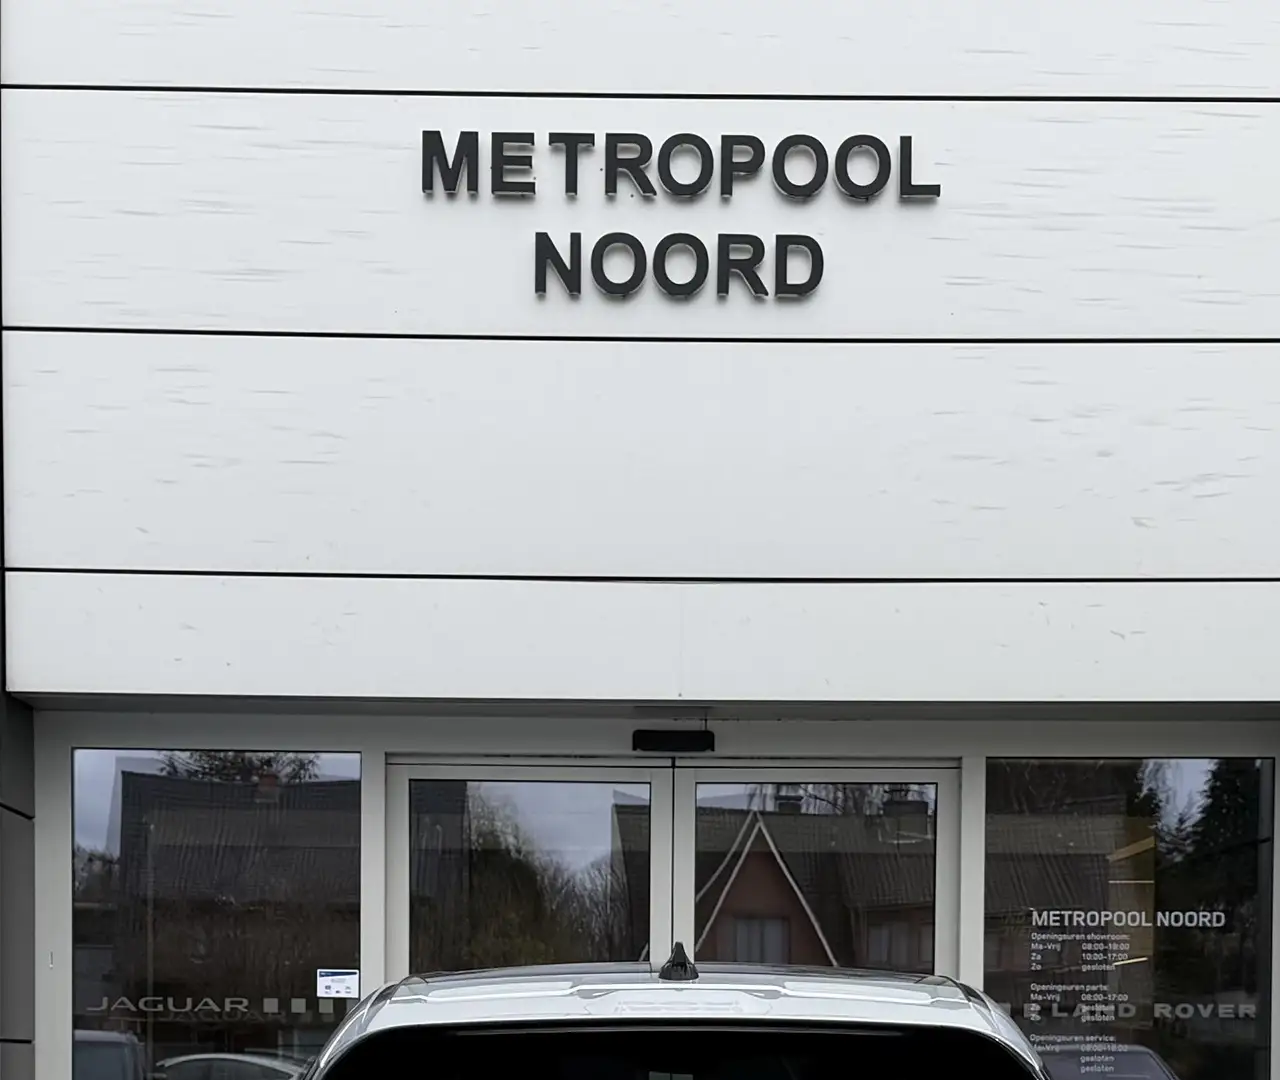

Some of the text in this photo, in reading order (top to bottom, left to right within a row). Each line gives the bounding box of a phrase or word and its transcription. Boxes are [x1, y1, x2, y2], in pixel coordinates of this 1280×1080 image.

[421, 129, 941, 200] METROPOOL
[534, 231, 825, 300] NOORD
[1032, 911, 1226, 927] METROPOOL NOORD
[1081, 963, 1116, 971] gesloten
[86, 997, 249, 1012] JAGUAR
[1153, 1003, 1257, 1018] ROVER
